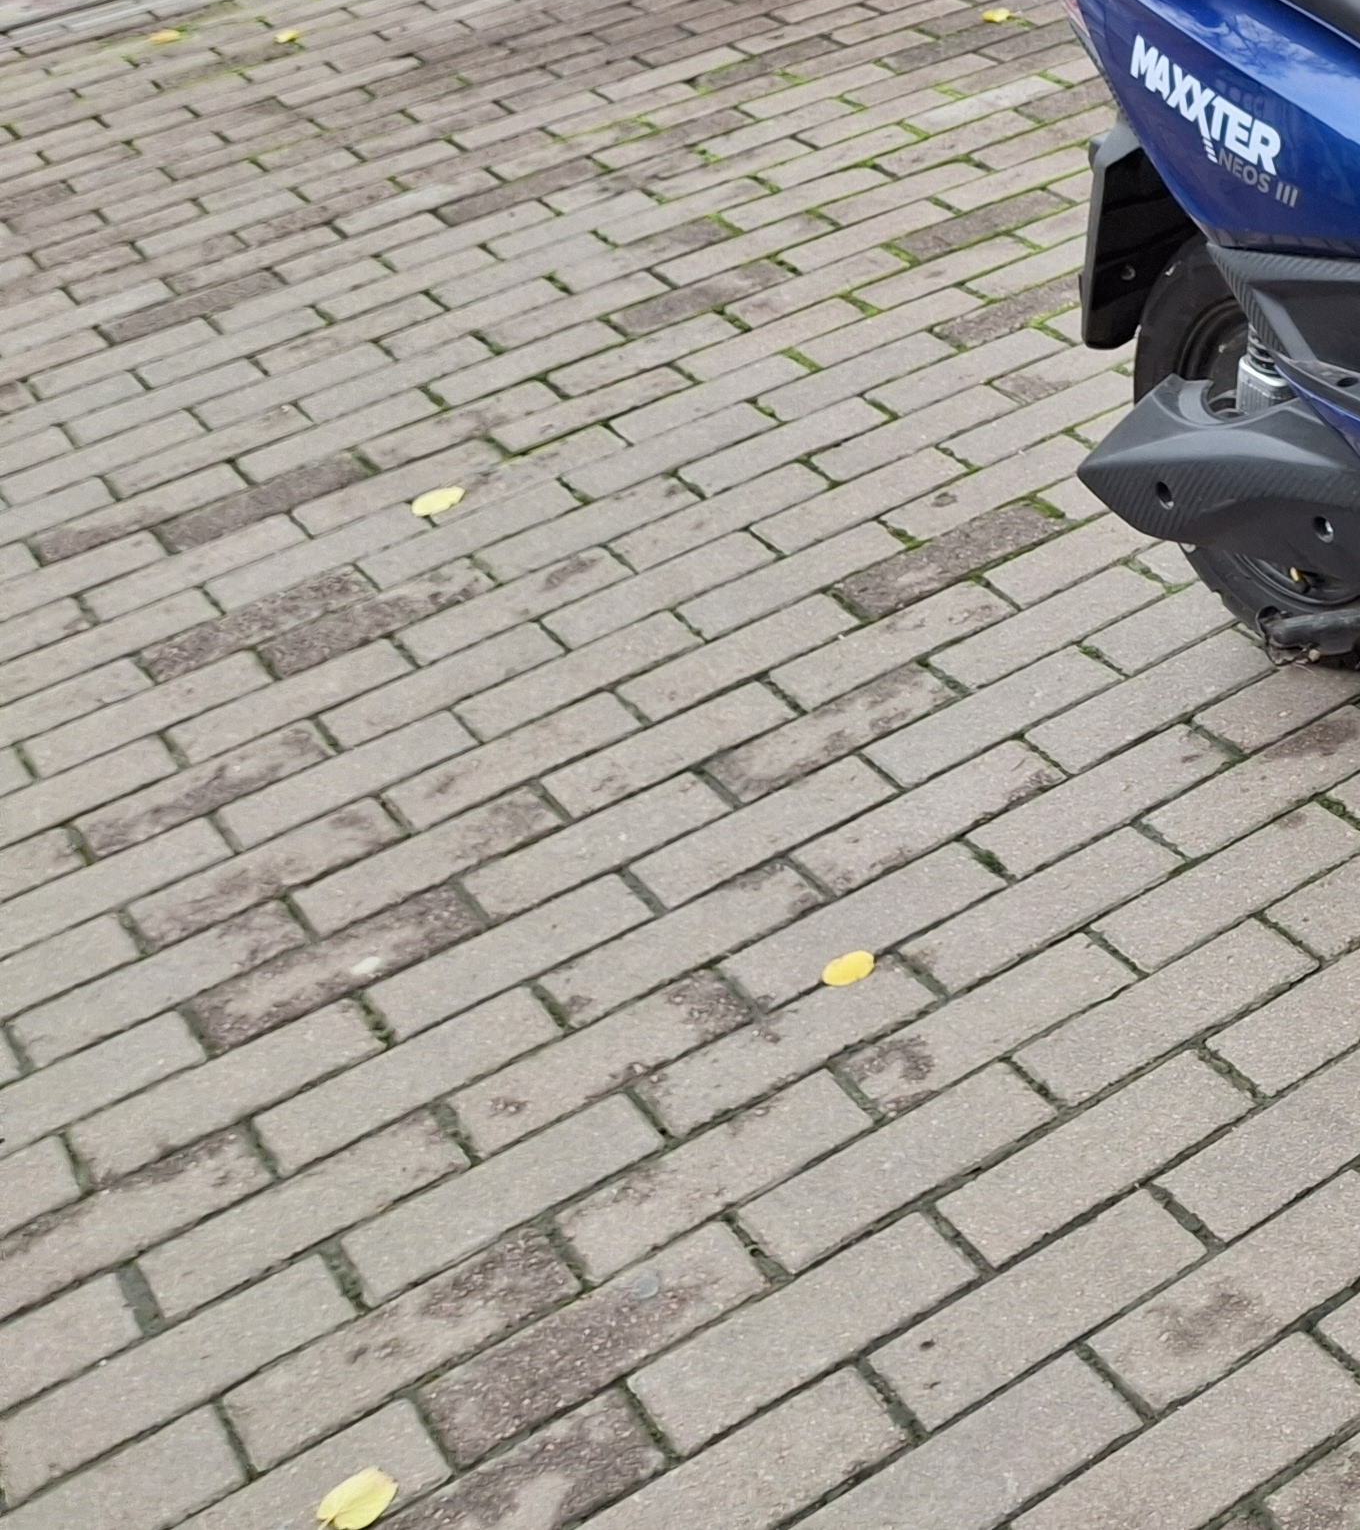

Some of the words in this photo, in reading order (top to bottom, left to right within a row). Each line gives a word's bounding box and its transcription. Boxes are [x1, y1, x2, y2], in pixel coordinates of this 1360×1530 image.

[1131, 34, 1281, 175] MAXXTER
[1219, 147, 1270, 194] NEOS
[1275, 181, 1299, 208] III
